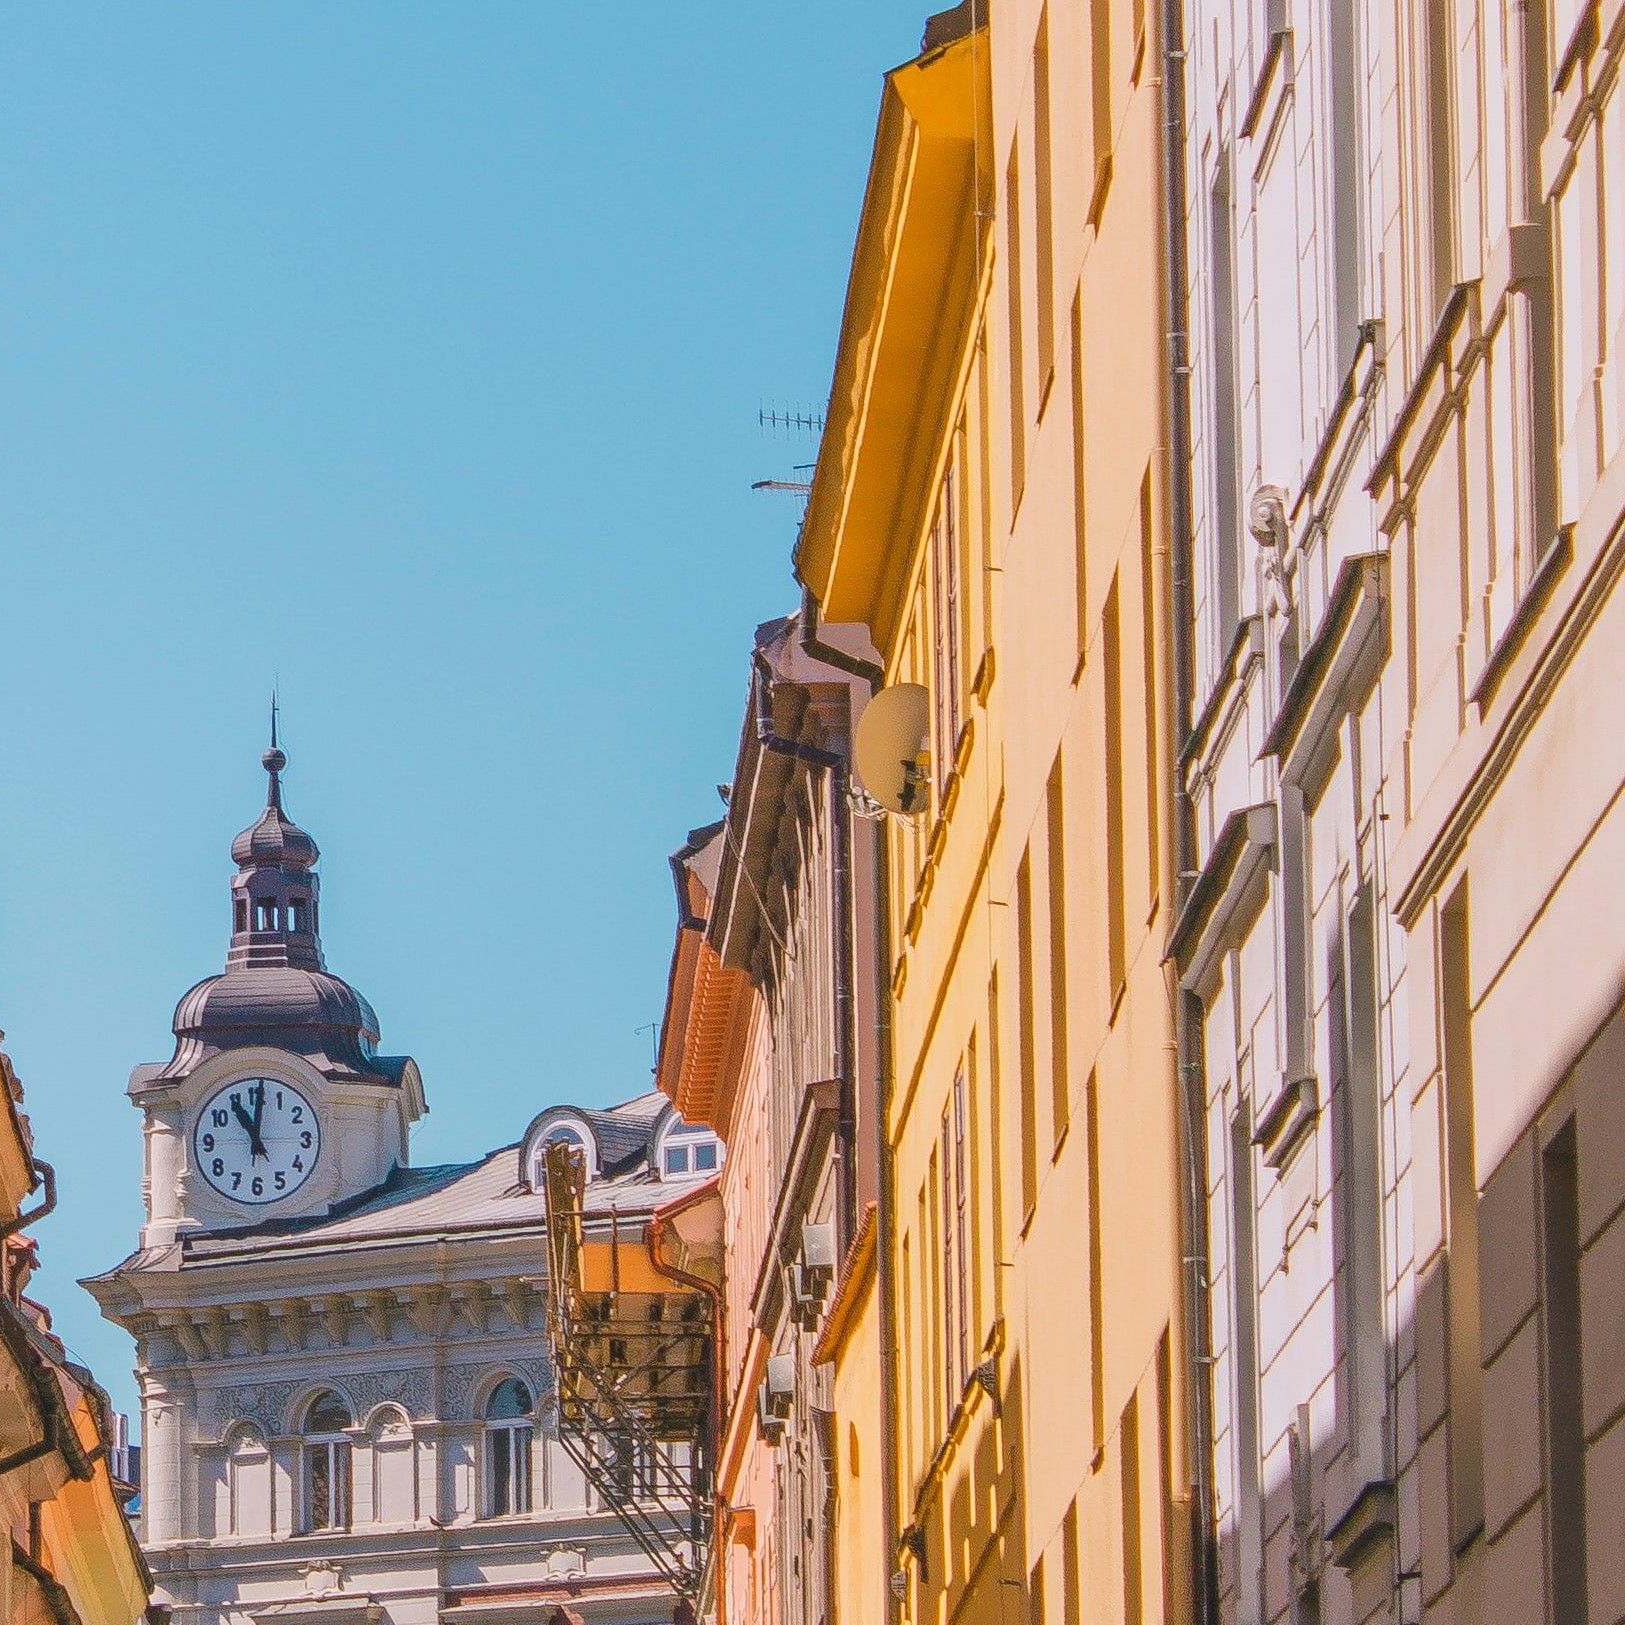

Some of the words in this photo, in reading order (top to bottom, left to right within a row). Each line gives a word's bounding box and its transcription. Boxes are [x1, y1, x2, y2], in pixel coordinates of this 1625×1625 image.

[276, 1091, 283, 1110] 1
[211, 1109, 228, 1128] 10
[291, 1106, 303, 1124] 2
[202, 1133, 214, 1152] 9
[300, 1131, 312, 1149] 3
[212, 1158, 224, 1177] 8
[292, 1154, 304, 1172] 4
[231, 1172, 242, 1190] 7
[252, 1177, 263, 1196] 6
[275, 1171, 286, 1190] 5
